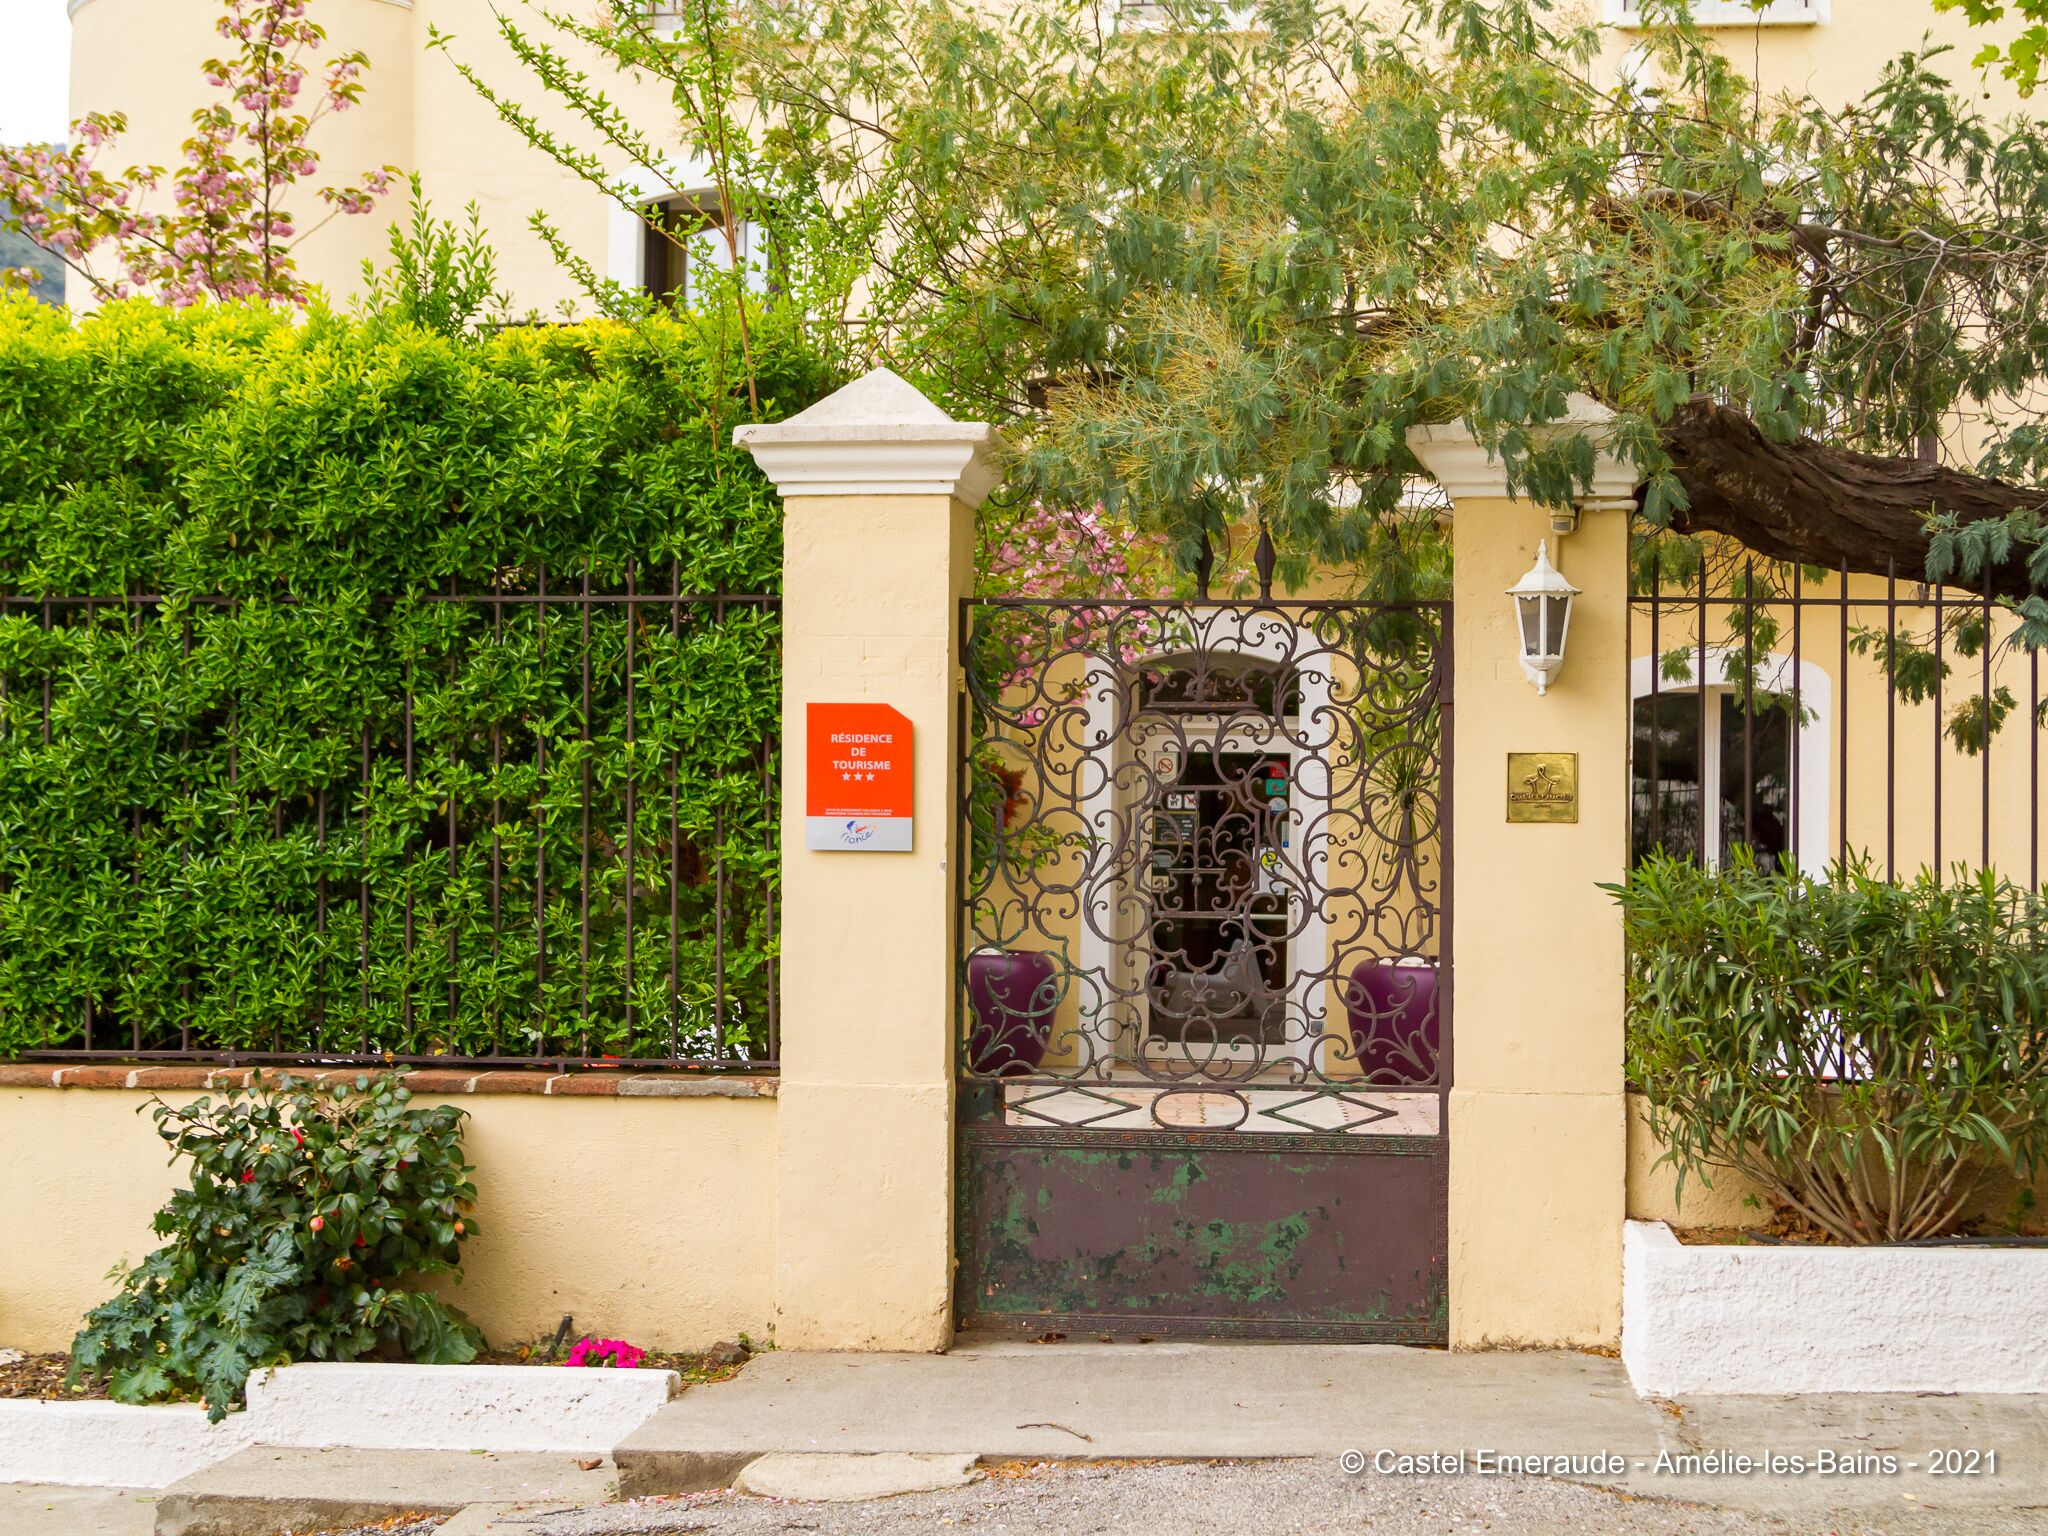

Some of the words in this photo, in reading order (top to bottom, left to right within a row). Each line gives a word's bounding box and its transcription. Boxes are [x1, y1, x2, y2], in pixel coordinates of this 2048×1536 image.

[831, 733, 893, 743] RÉSIDENCE
[851, 747, 866, 756] DE
[832, 760, 891, 770] TOURISME
